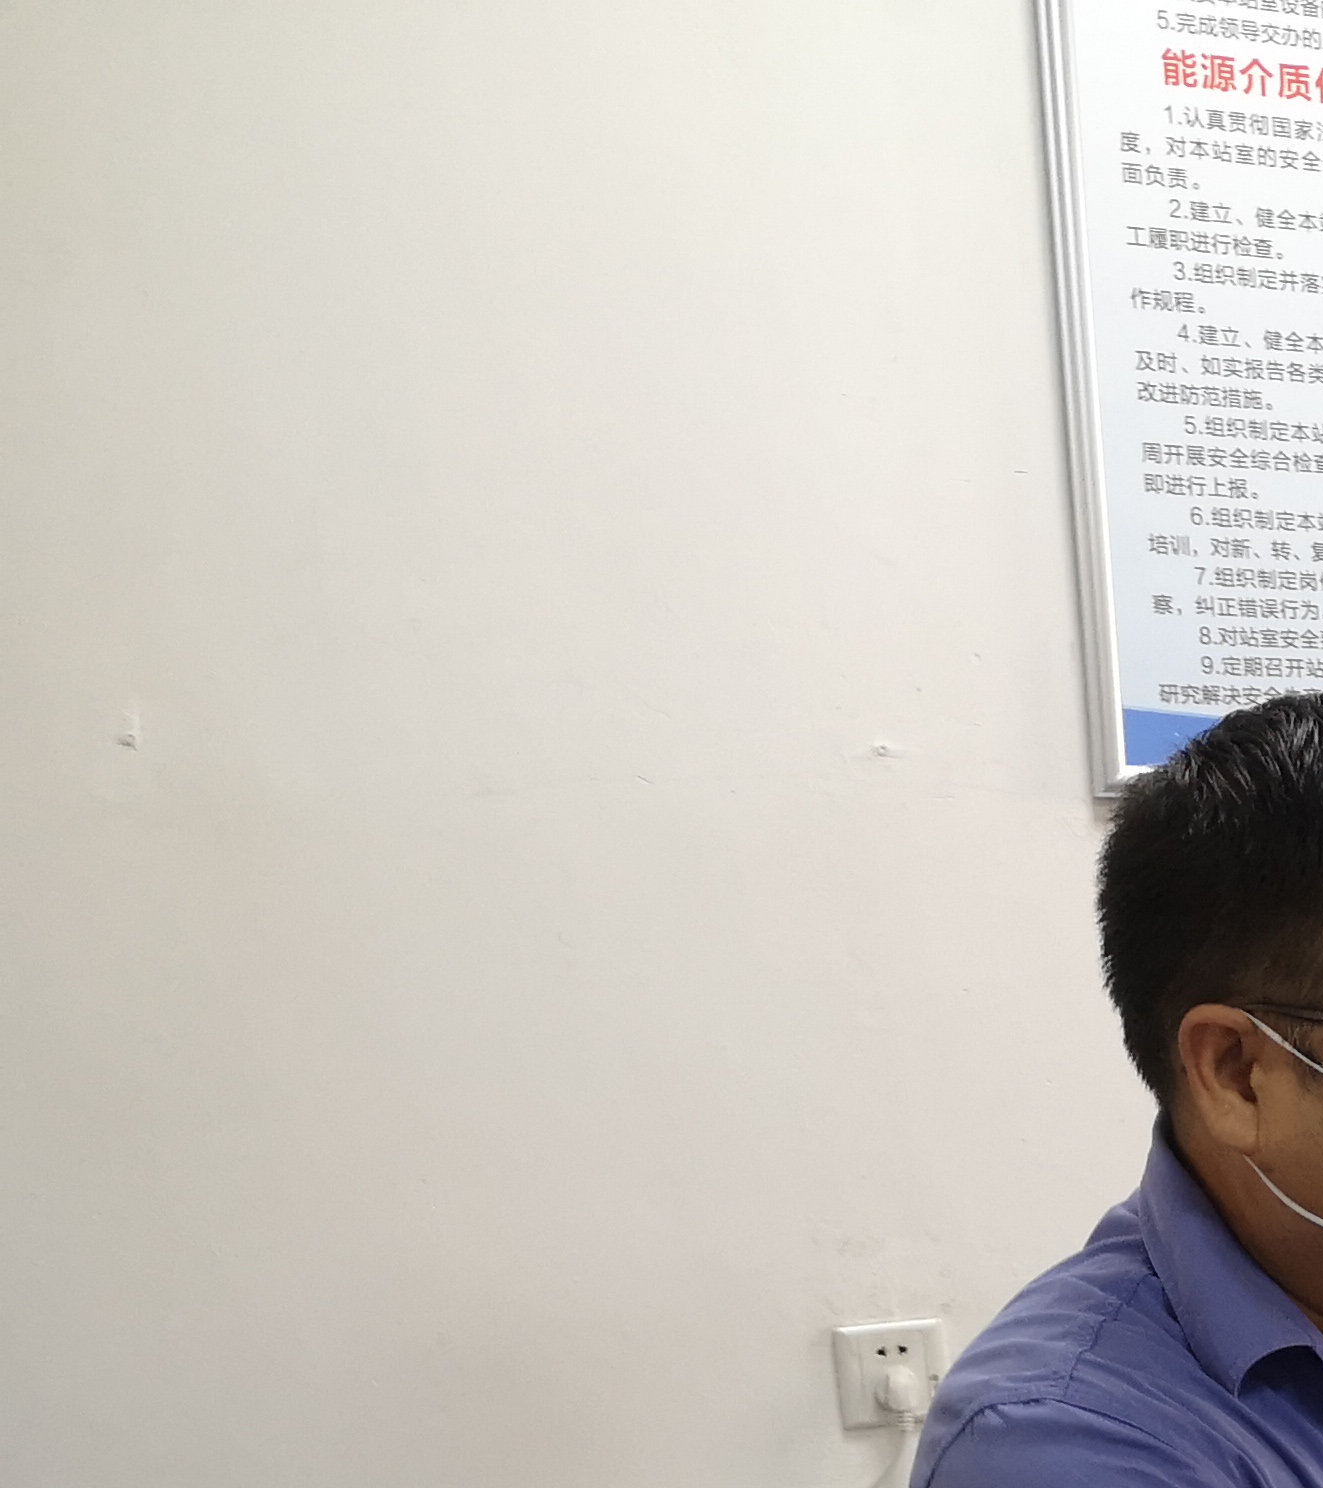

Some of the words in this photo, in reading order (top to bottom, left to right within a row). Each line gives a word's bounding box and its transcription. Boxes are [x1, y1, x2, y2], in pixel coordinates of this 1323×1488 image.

[1121, 163, 1200, 190] 面负责。
[1126, 226, 1284, 260] 工履职进行检查。
[1131, 288, 1206, 314] 作规程。
[1137, 381, 1273, 411] 改进防范措施。
[1144, 473, 1259, 499] 即进行上报。
